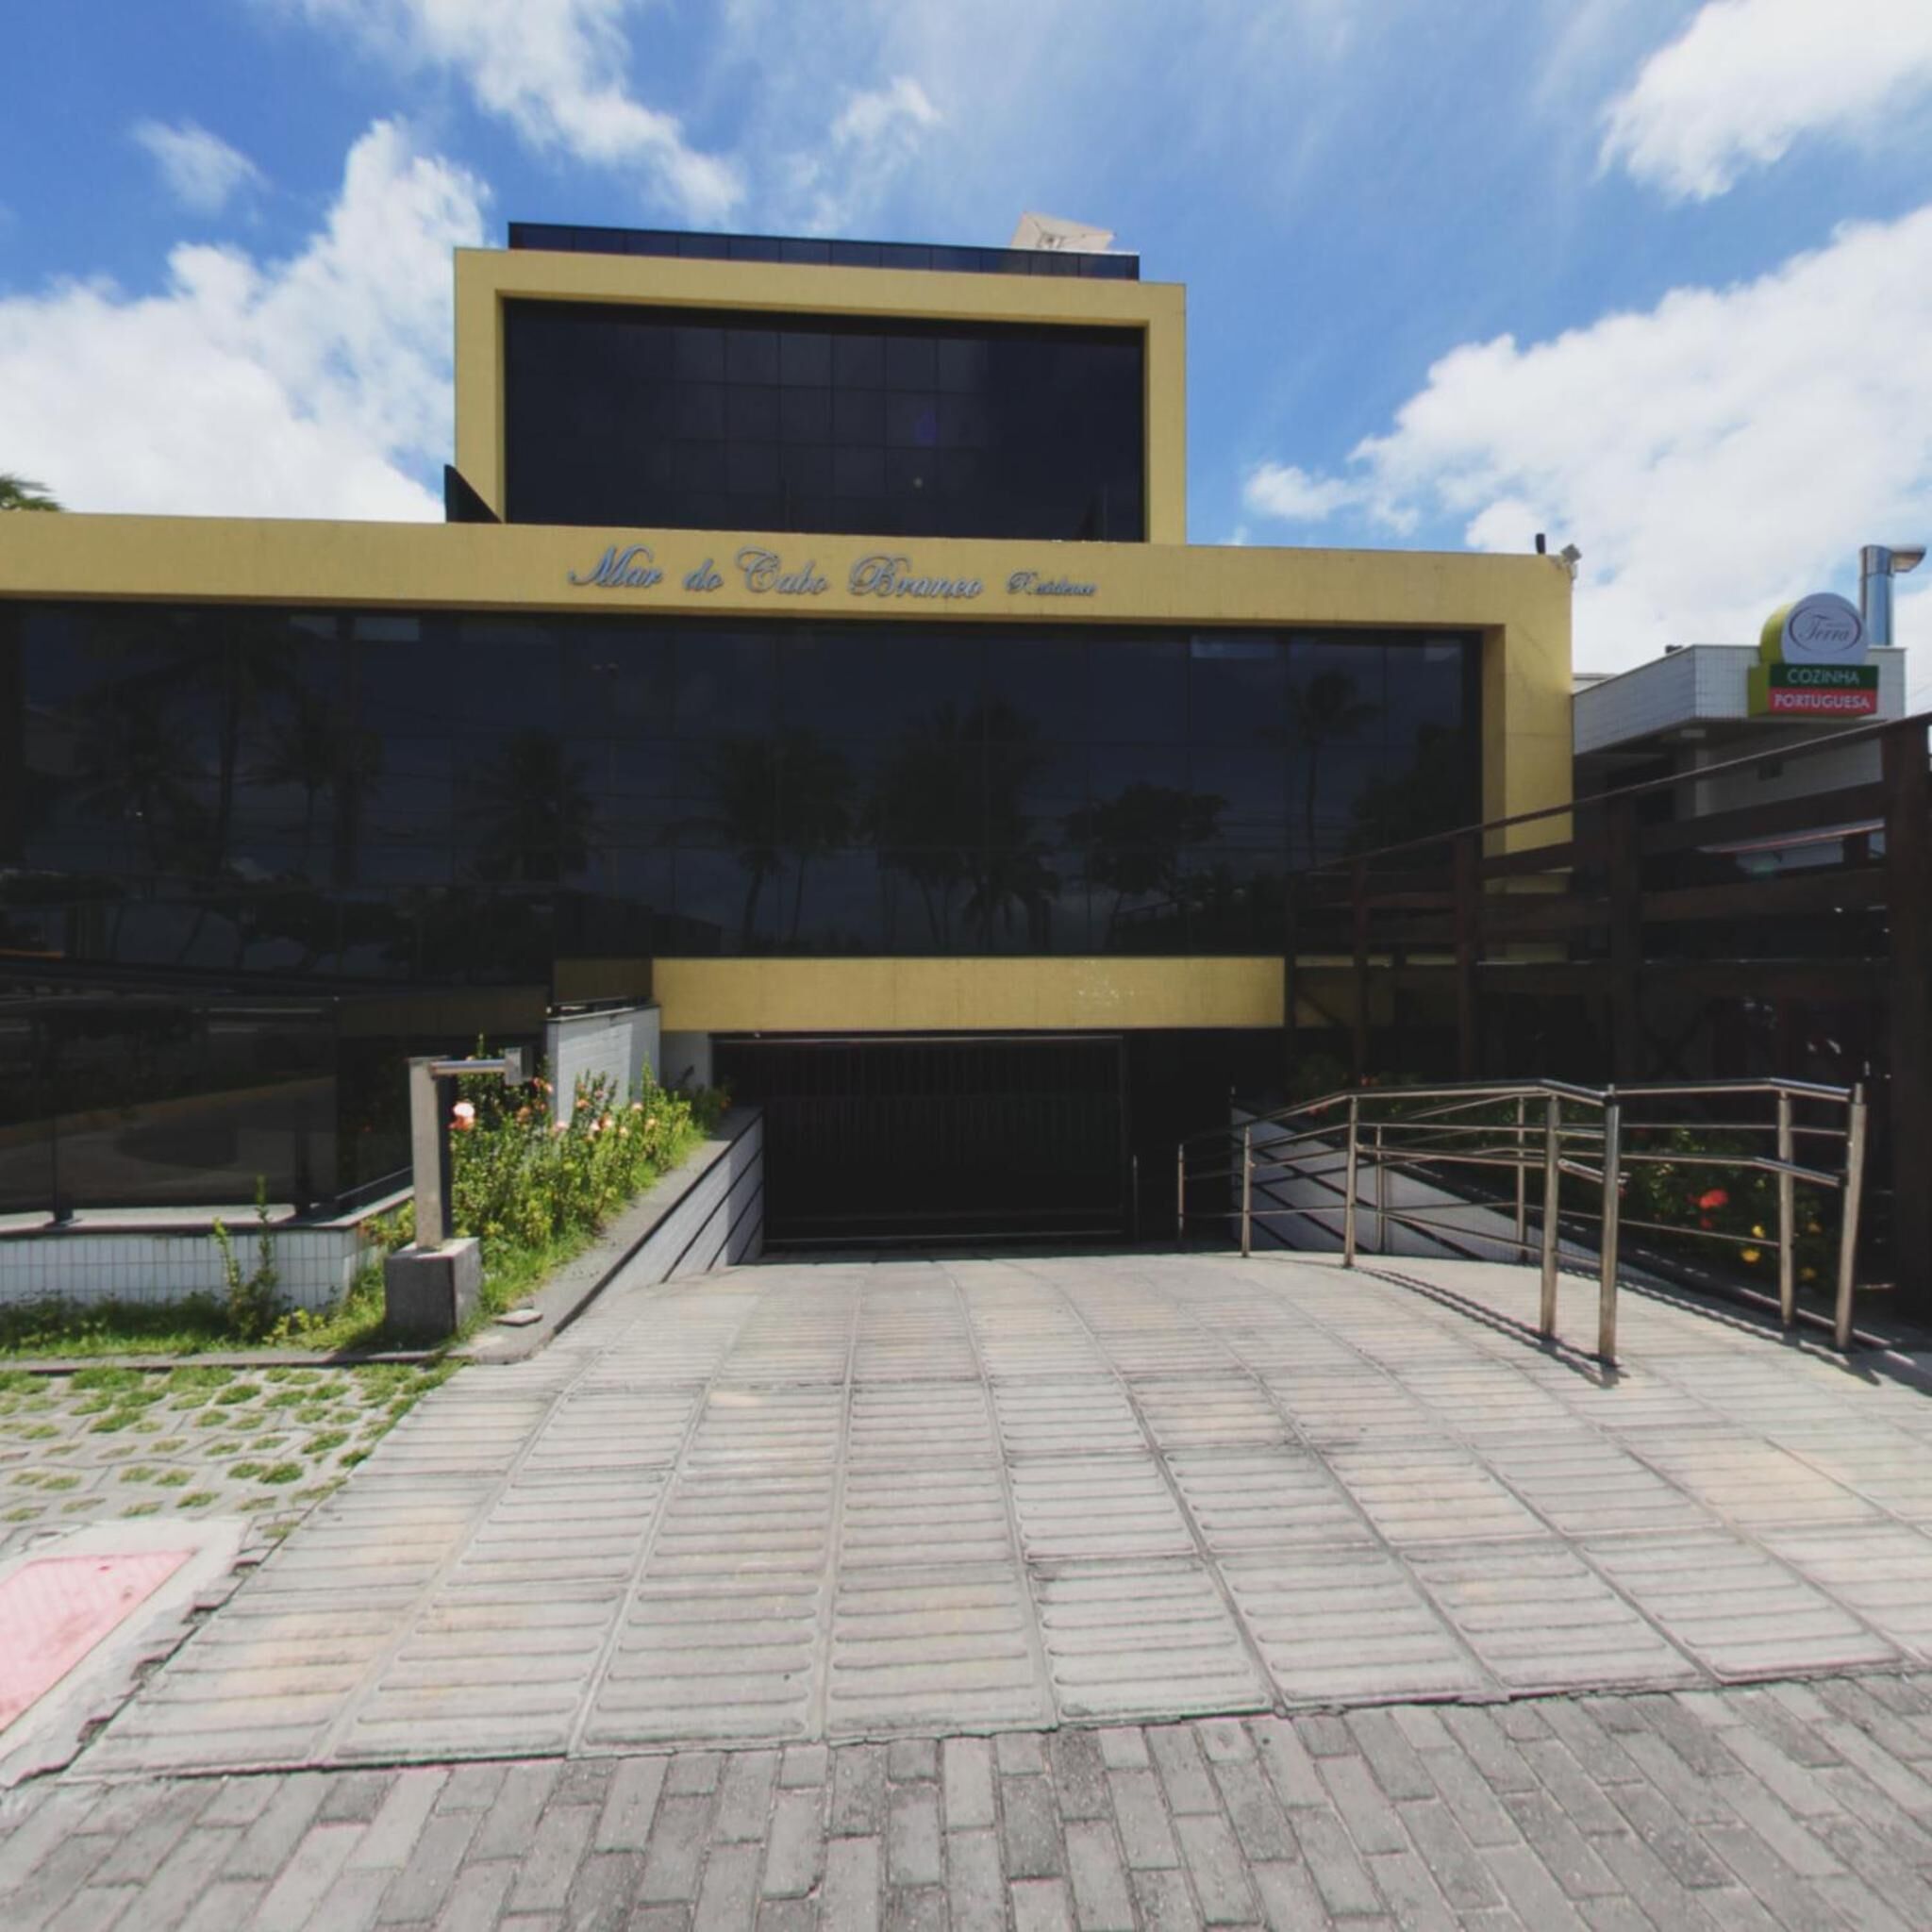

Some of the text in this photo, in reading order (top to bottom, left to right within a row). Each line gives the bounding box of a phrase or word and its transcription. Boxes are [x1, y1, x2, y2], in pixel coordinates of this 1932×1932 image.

[568, 544, 663, 588] Mar
[734, 543, 831, 596] Cabo
[846, 552, 985, 599] Branco
[1787, 668, 1860, 686] COZINHA
[1774, 693, 1871, 709] PORTUGUESA
